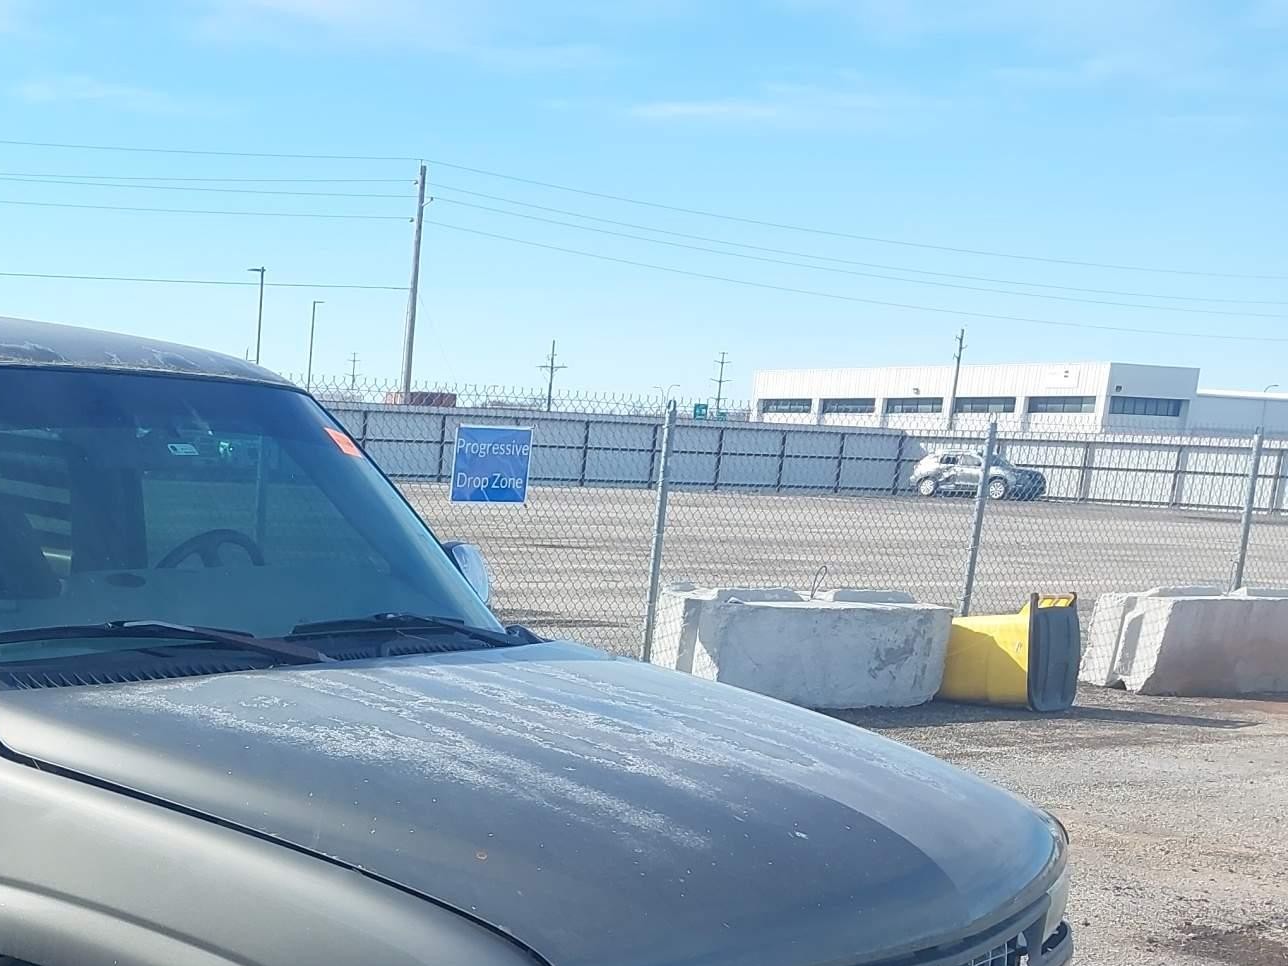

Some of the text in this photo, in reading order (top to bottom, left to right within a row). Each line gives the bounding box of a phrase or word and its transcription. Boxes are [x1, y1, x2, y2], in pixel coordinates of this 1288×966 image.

[456, 438, 530, 458] Progressive
[456, 472, 523, 490] Drop Zone
